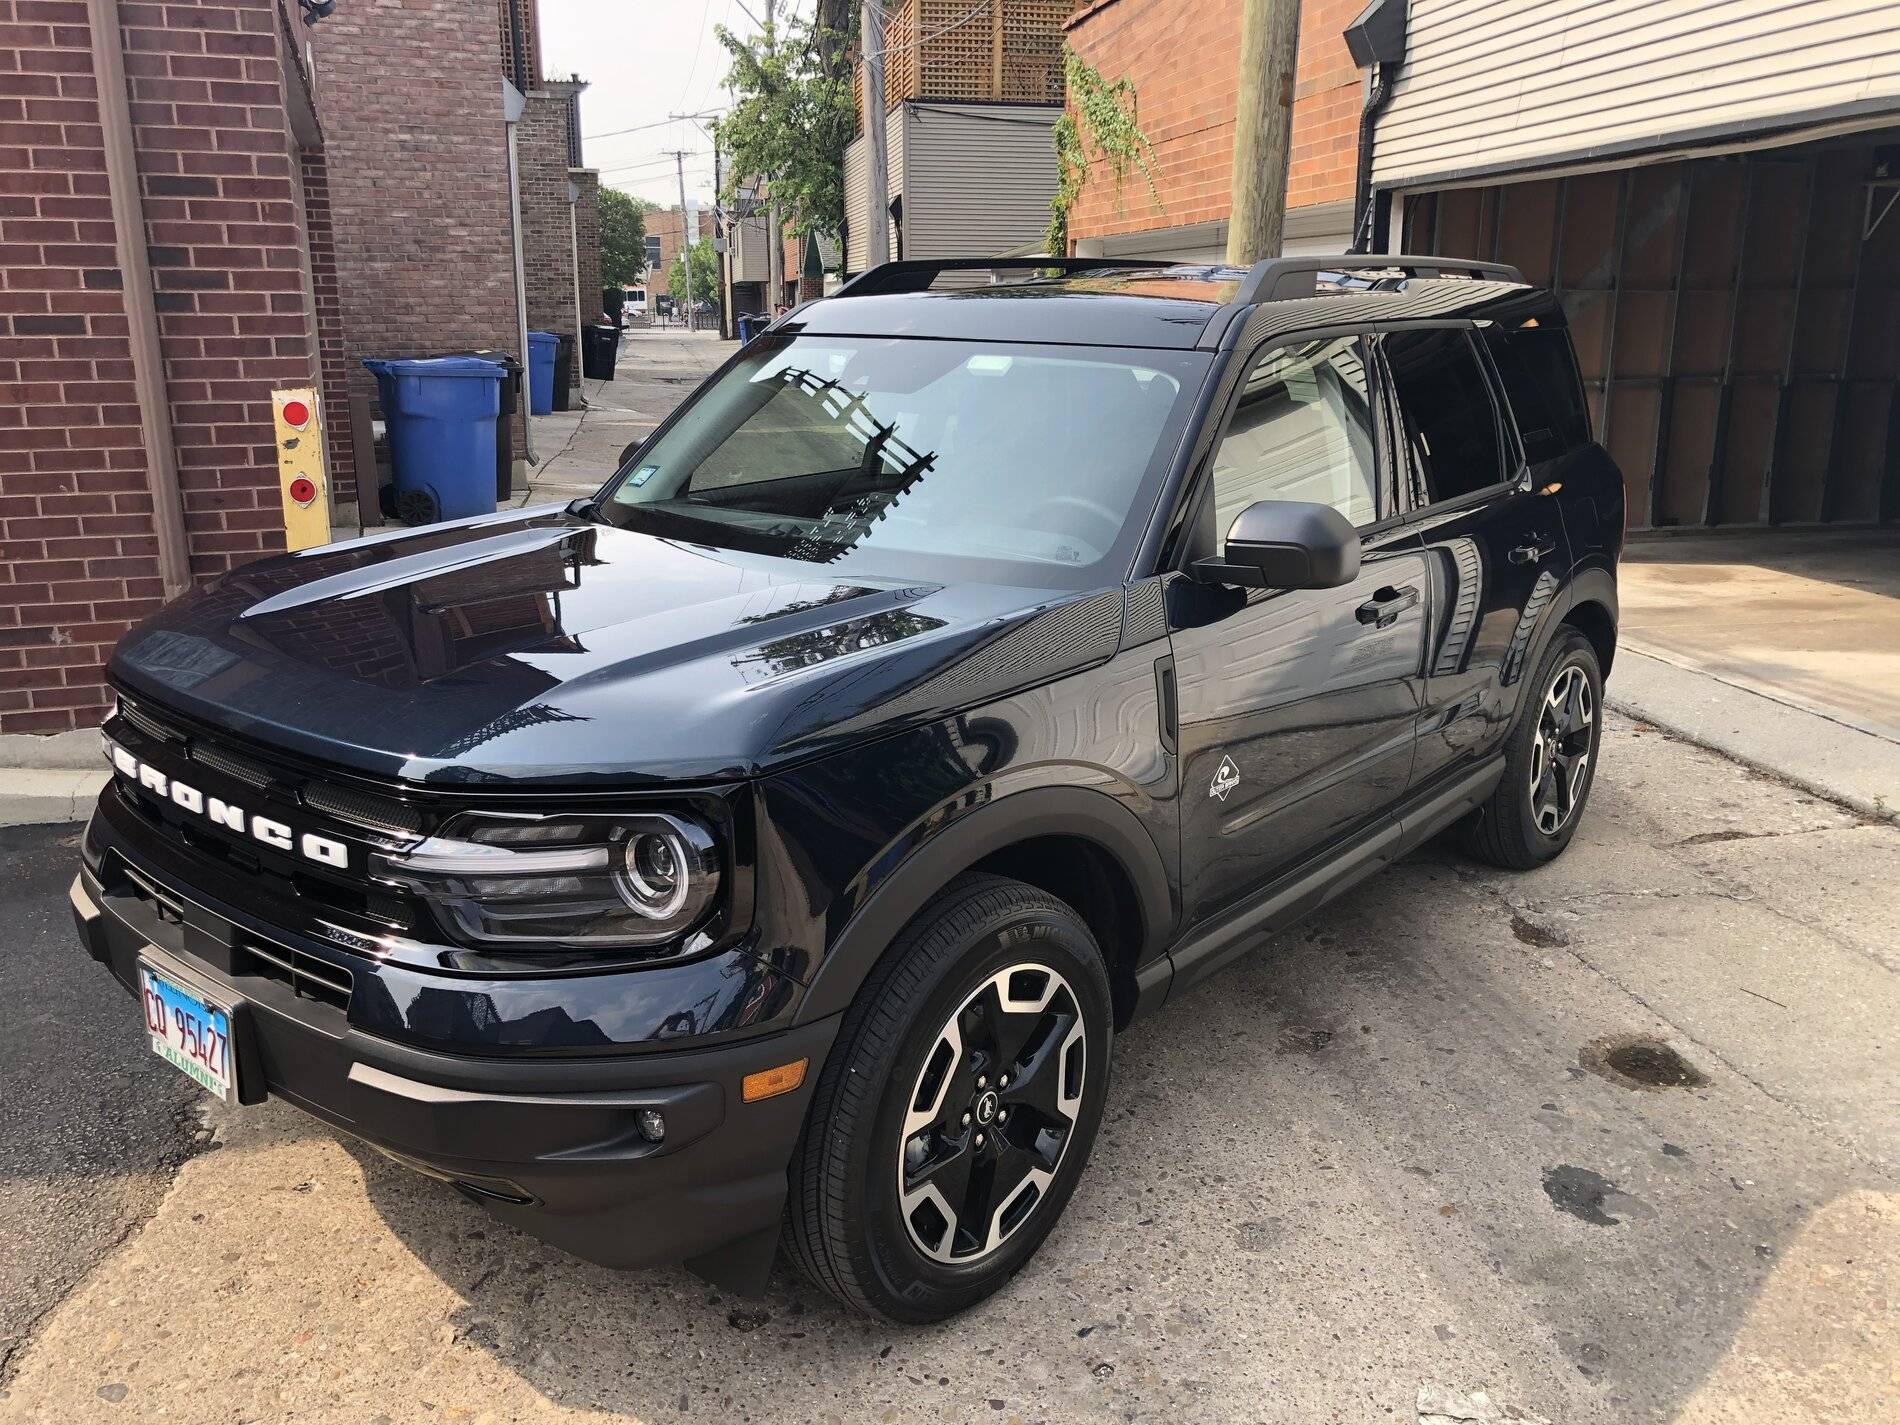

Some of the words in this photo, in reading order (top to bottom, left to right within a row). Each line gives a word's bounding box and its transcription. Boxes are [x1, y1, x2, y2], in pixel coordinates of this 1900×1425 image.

[112, 747, 349, 869] BRONCO
[165, 1046, 213, 1091] ALUMNI
[175, 1007, 226, 1079] 95427
